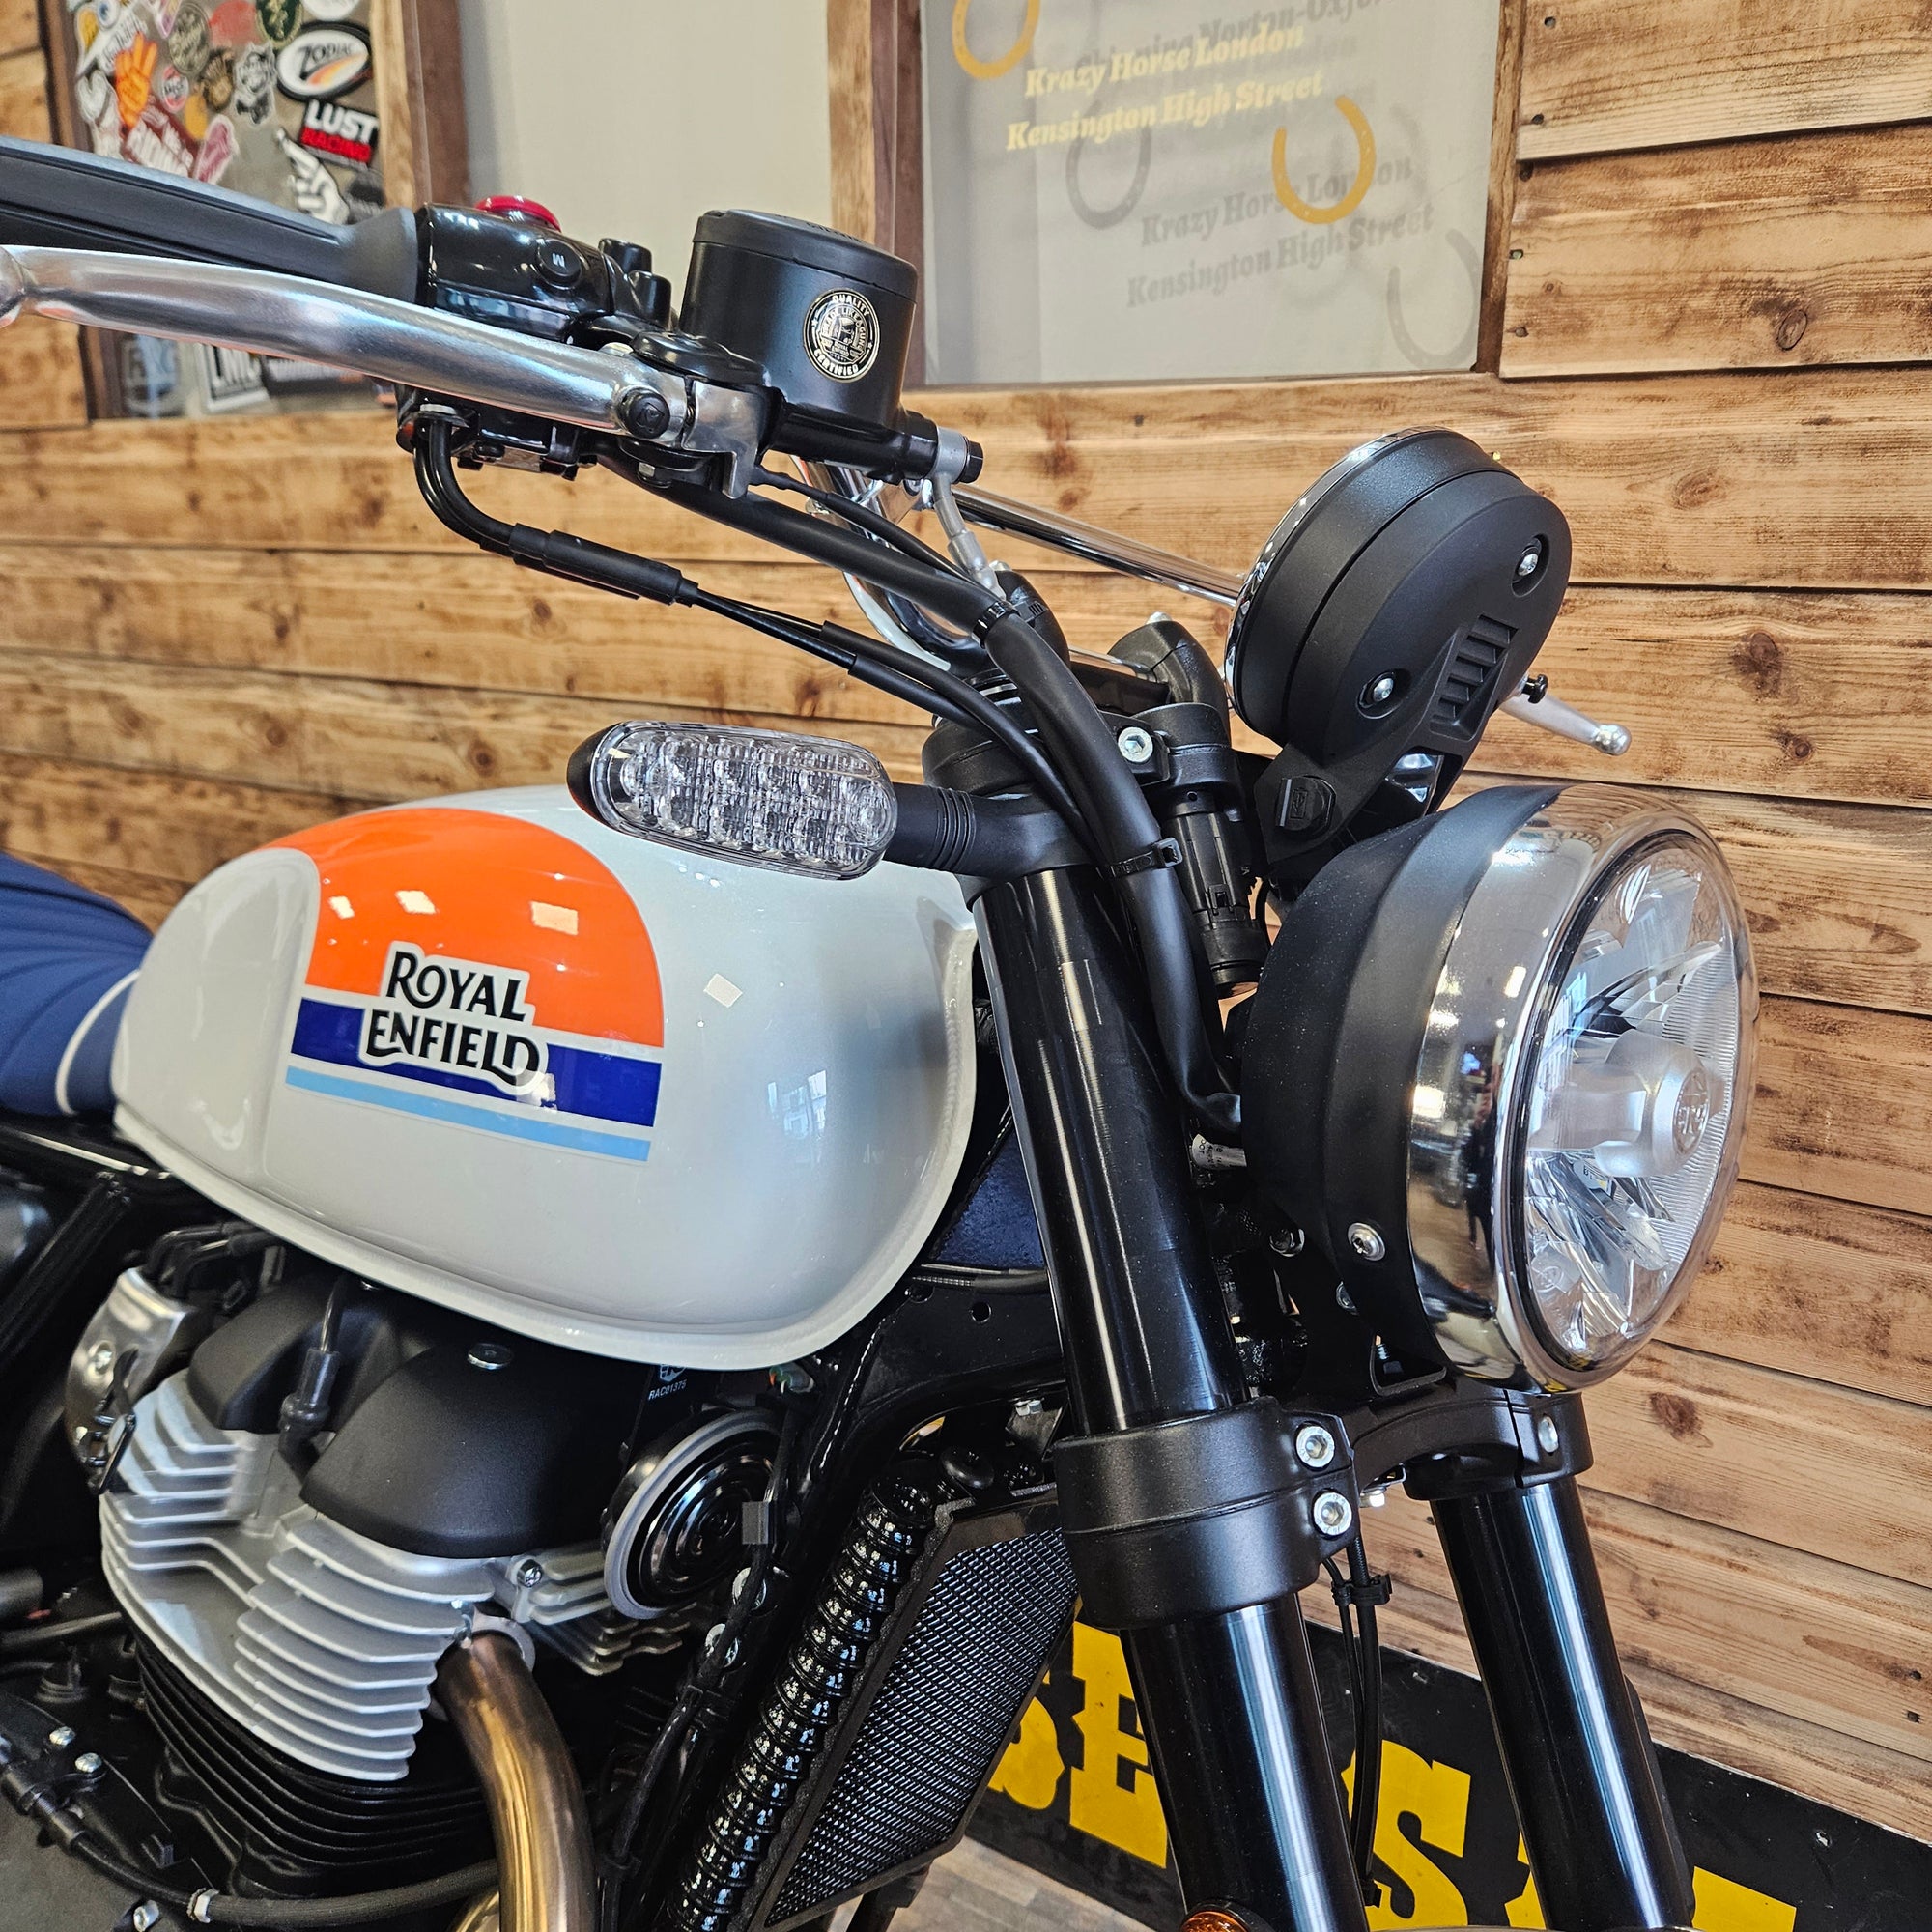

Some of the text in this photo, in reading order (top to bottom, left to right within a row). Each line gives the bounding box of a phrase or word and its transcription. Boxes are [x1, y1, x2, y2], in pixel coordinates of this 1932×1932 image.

[1025, 64, 1107, 98] Krazy
[1109, 46, 1192, 84] Horse
[1193, 21, 1305, 68] London
[305, 99, 379, 144] LUST
[1006, 68, 1324, 152] Kensington High Street
[1223, 185, 1300, 227] Hors
[1306, 156, 1413, 204] Lonon
[1276, 223, 1346, 270] High
[1348, 201, 1435, 252] Street
[832, 294, 869, 316] QUALITY
[813, 349, 859, 376] CERTIFIED
[385, 951, 526, 1022] ROYAL
[366, 1009, 540, 1087] ENFIELD
